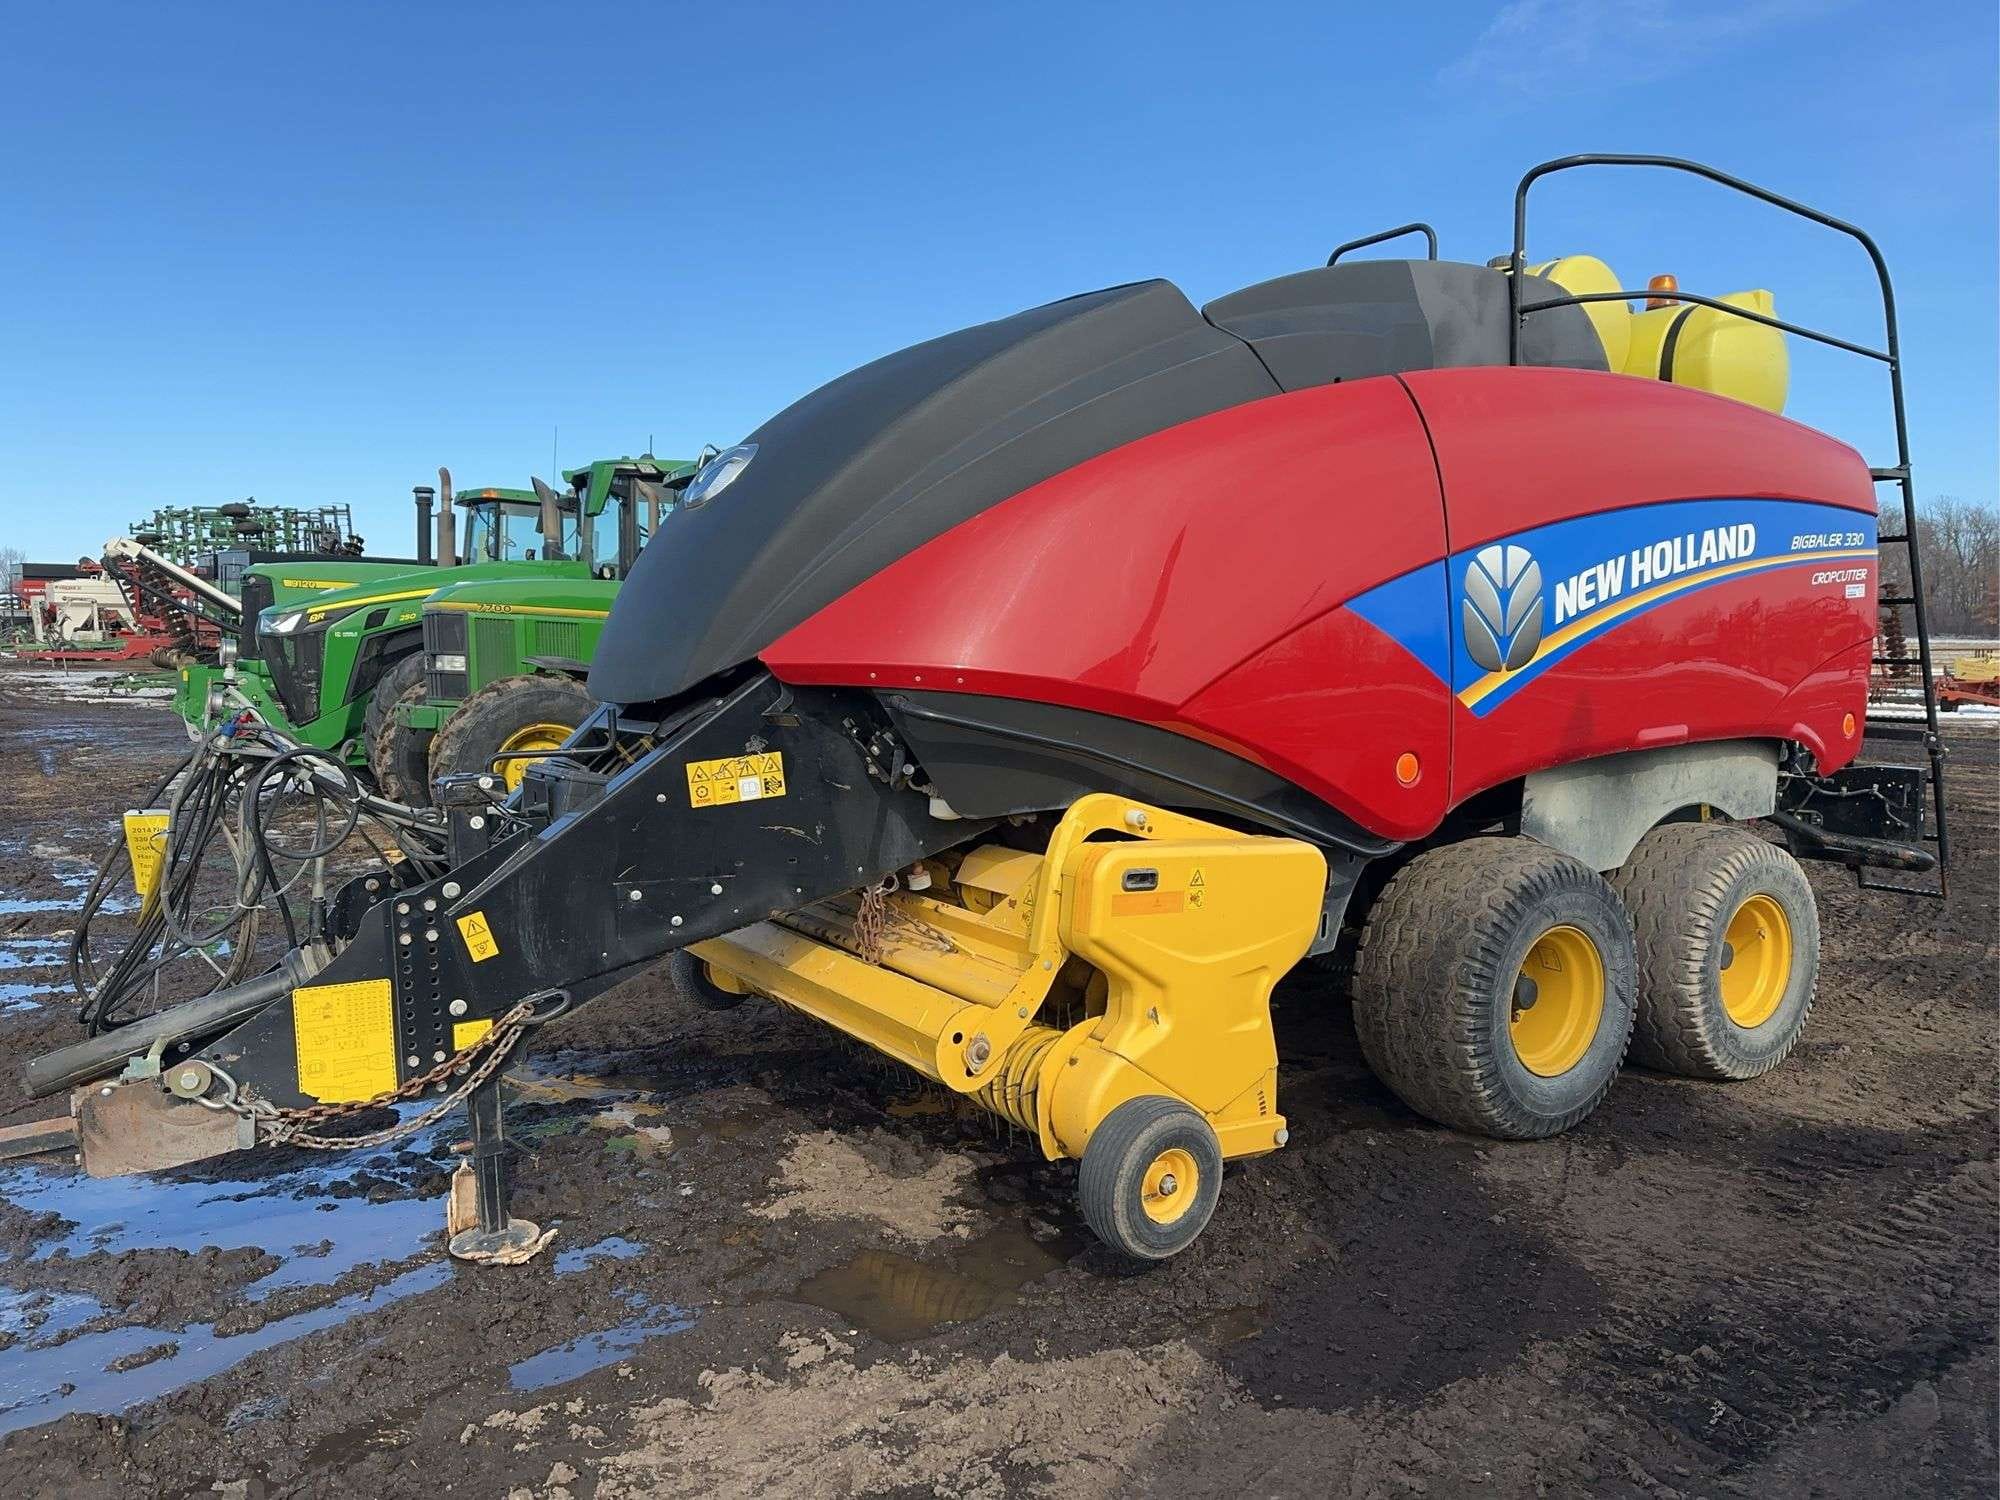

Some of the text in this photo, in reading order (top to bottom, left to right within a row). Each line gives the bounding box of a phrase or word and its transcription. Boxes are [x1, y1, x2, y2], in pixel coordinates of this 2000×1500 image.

[1791, 532, 1864, 550] BIGBALER 330
[1555, 523, 1756, 624] NEW HOLLAND
[1811, 568, 1868, 585] CROPCUTTER
[478, 604, 512, 612] 7700
